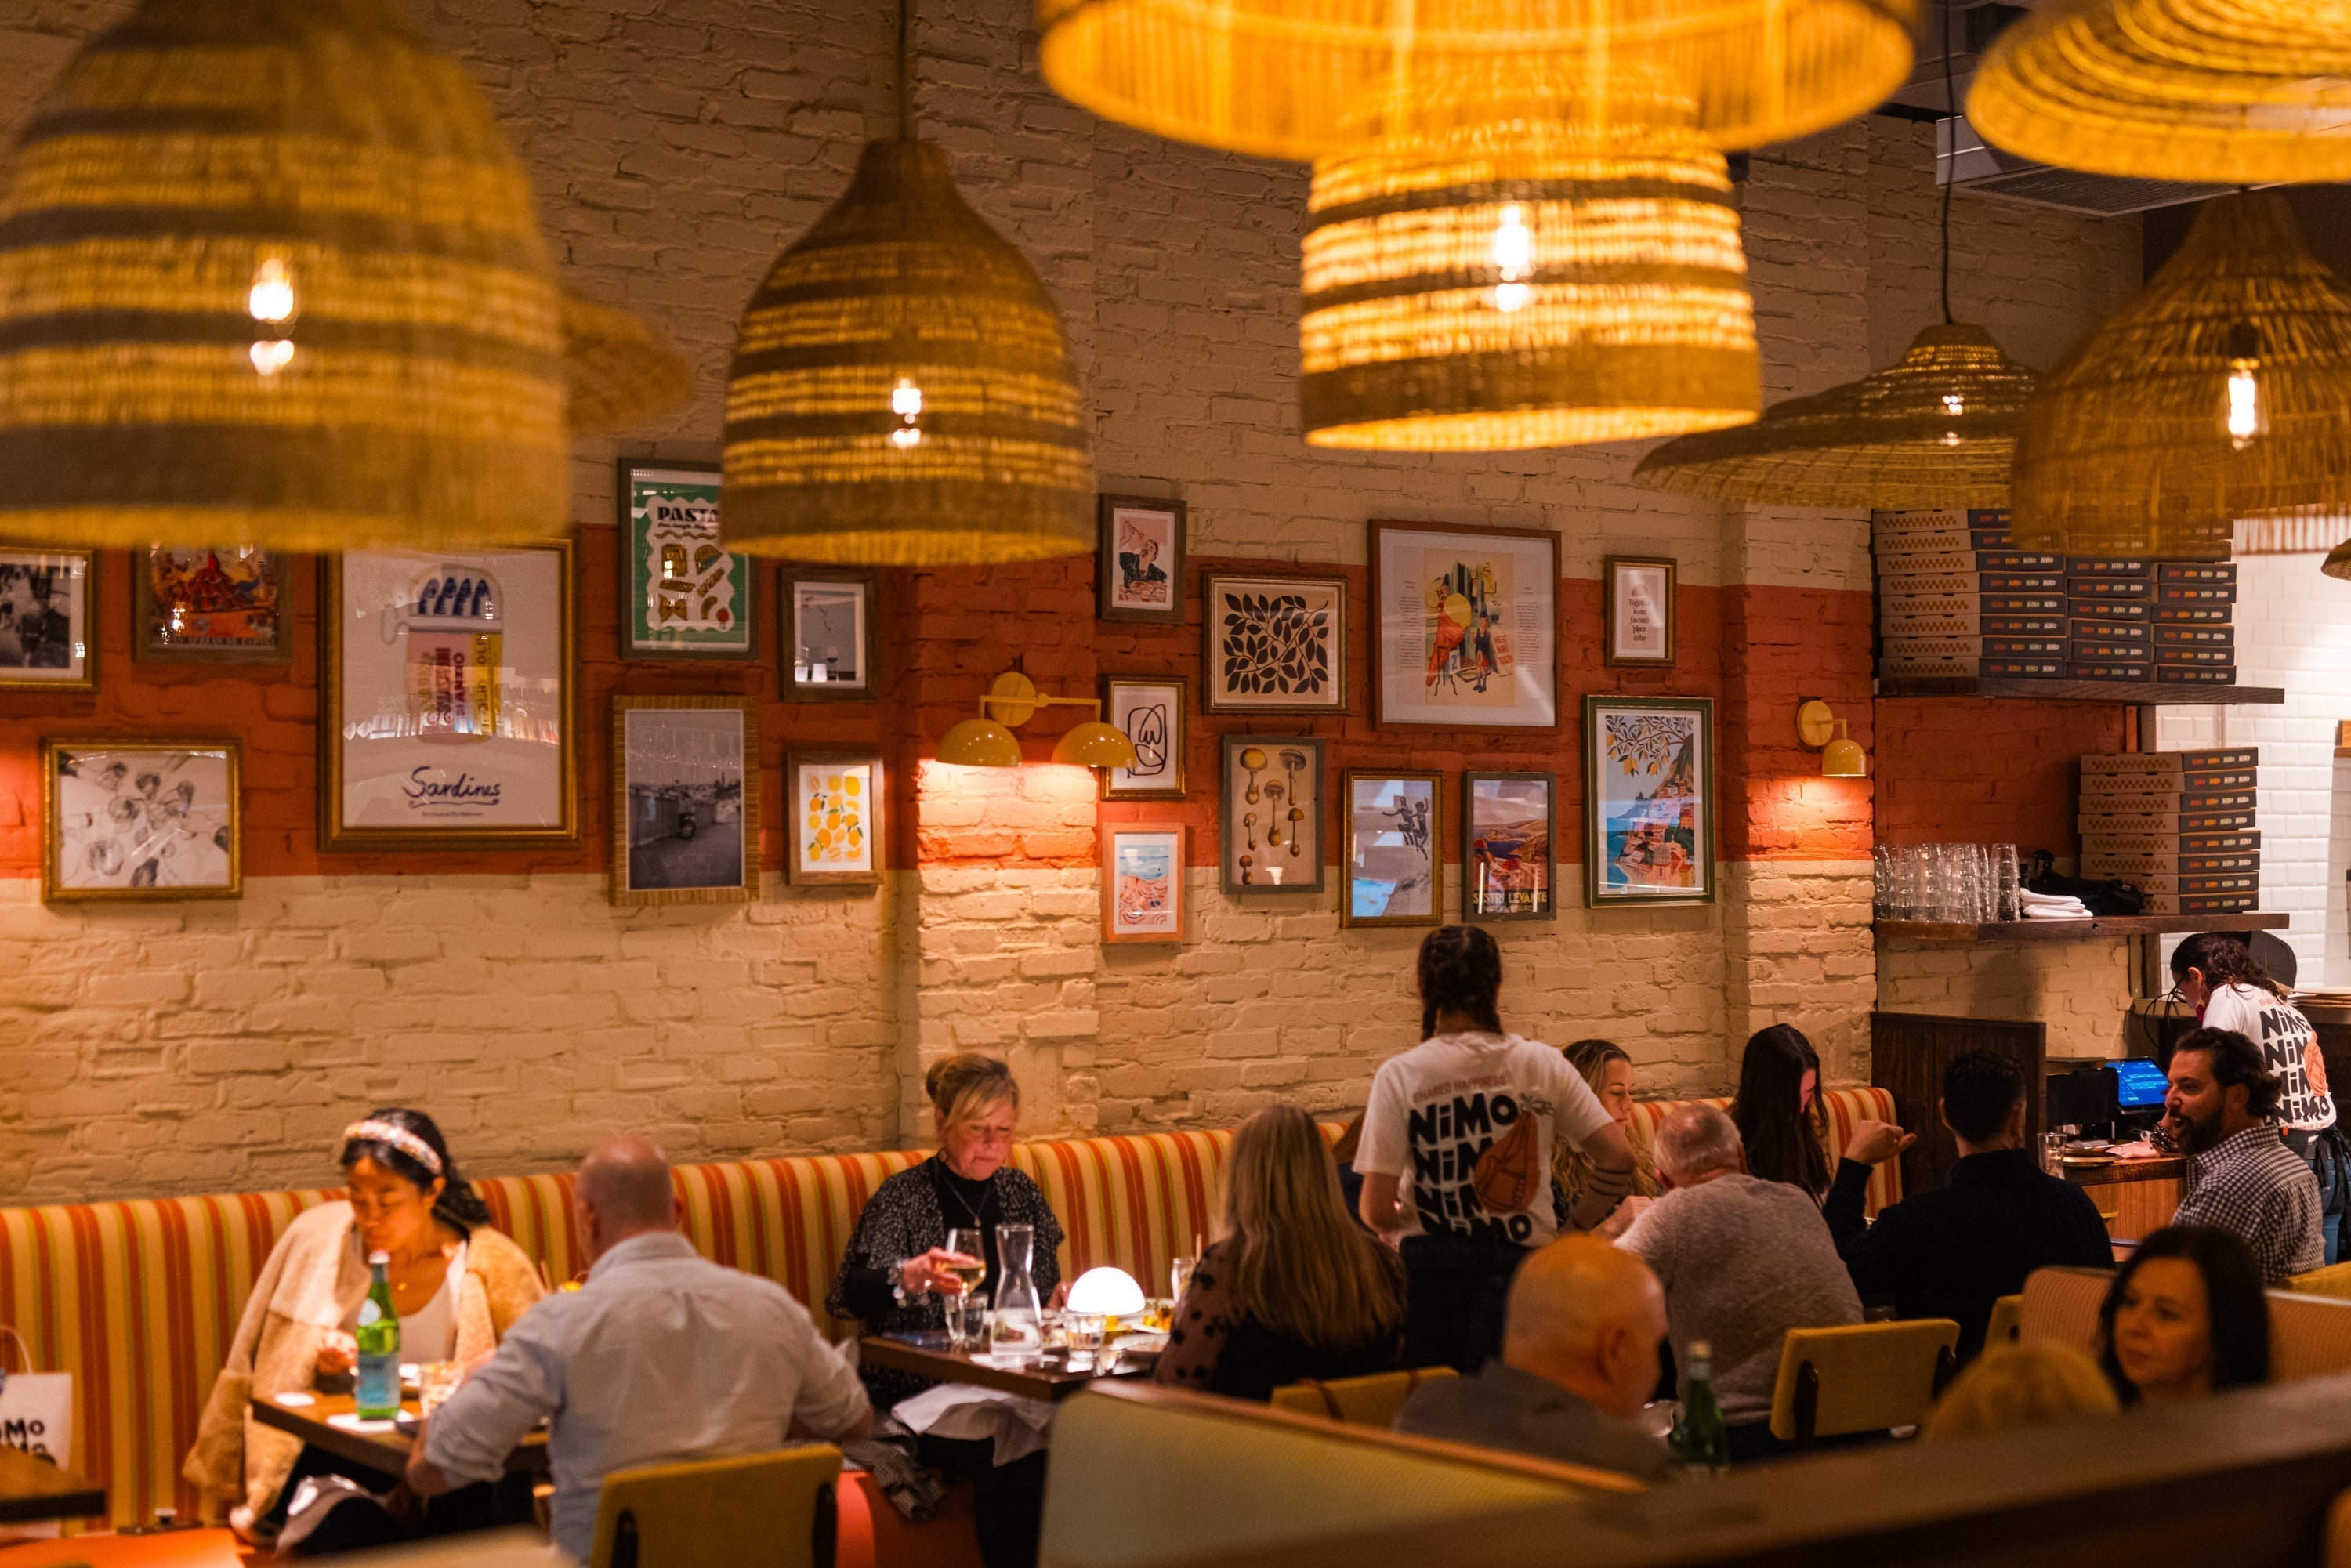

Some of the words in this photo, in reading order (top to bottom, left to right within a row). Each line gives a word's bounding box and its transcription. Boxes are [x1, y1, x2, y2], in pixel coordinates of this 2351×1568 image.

[1628, 599, 1650, 608] Togeth
[401, 766, 501, 798] Sardines
[1473, 892, 1505, 904] SSTRI
[0, 1418, 45, 1443] MO
